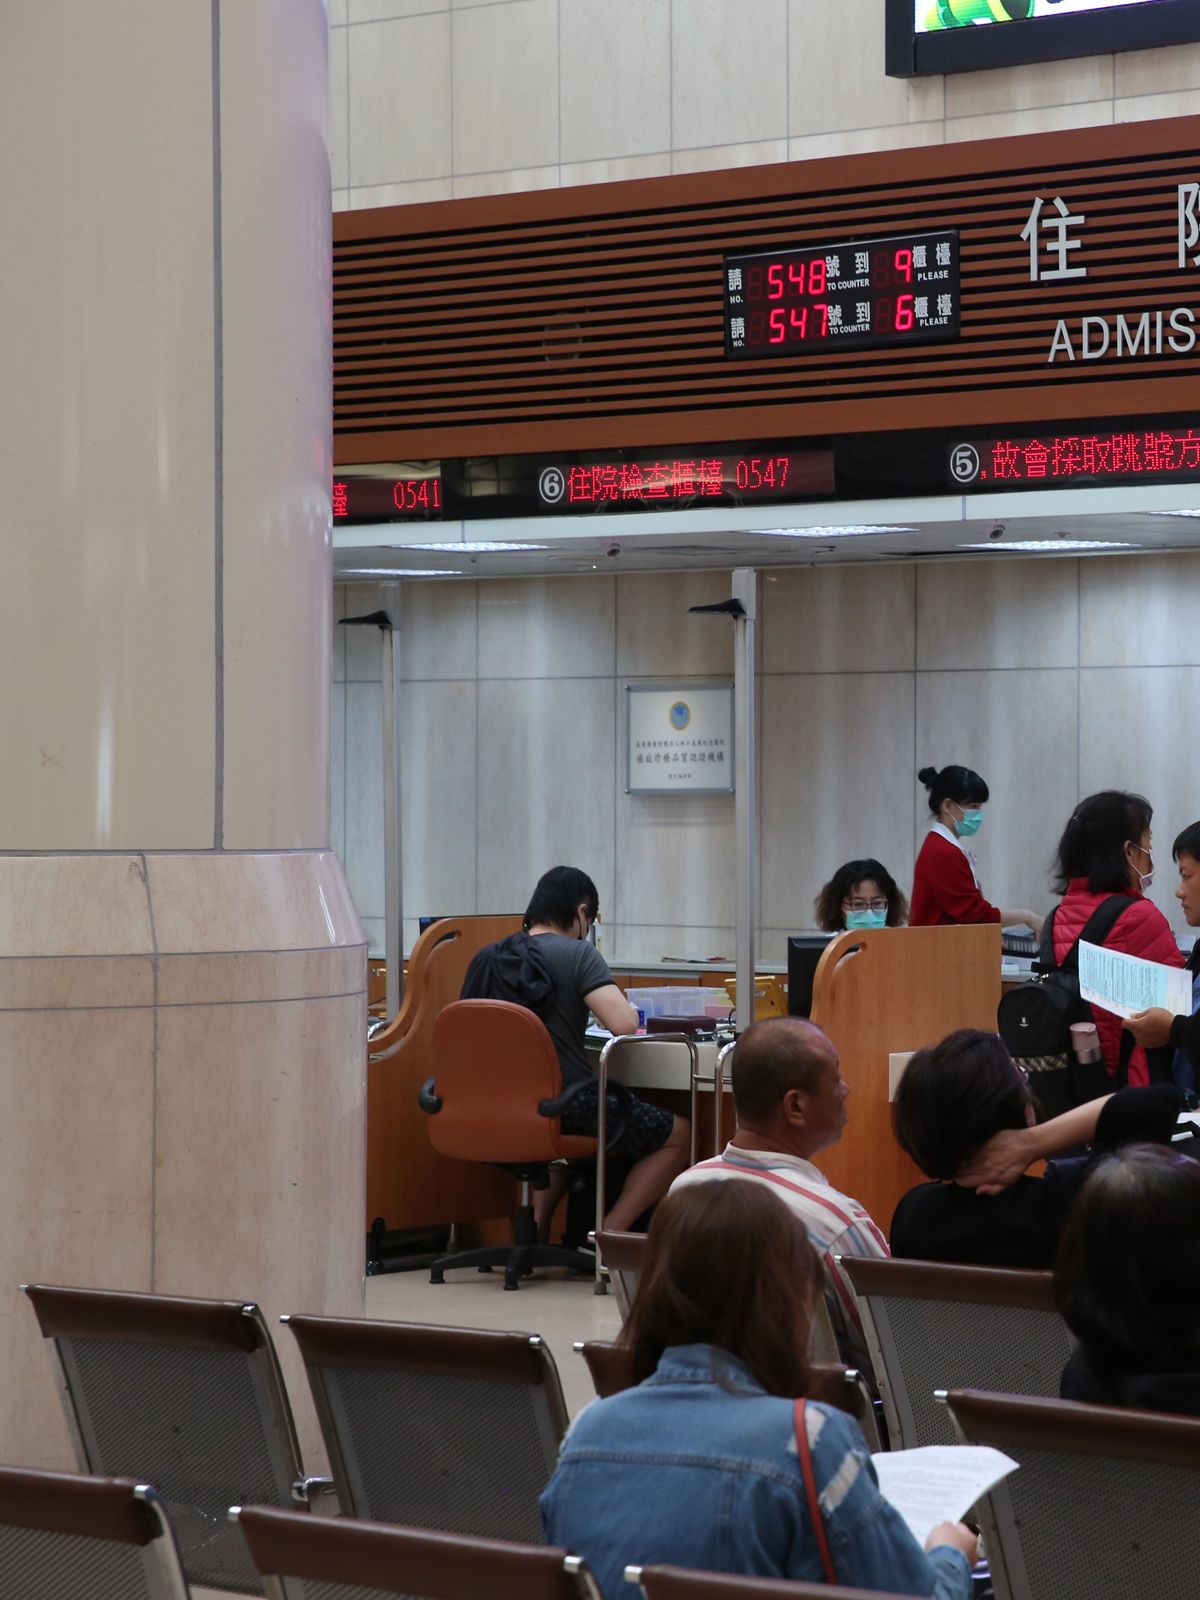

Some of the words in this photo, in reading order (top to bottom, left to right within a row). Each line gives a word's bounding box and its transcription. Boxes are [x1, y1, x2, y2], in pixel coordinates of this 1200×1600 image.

[728, 268, 743, 291] 請
[730, 295, 744, 304] NO.
[827, 282, 837, 291] TO
[838, 278, 870, 290] COUNTER
[917, 270, 949, 281] PLEASE
[730, 317, 745, 339] 請
[829, 327, 839, 335] TO
[840, 323, 870, 334] COUNTER
[919, 317, 948, 327] PLEASE
[735, 457, 789, 489] 0547
[953, 448, 975, 477] 5
[393, 479, 440, 509] 0541
[541, 471, 563, 499] 6
